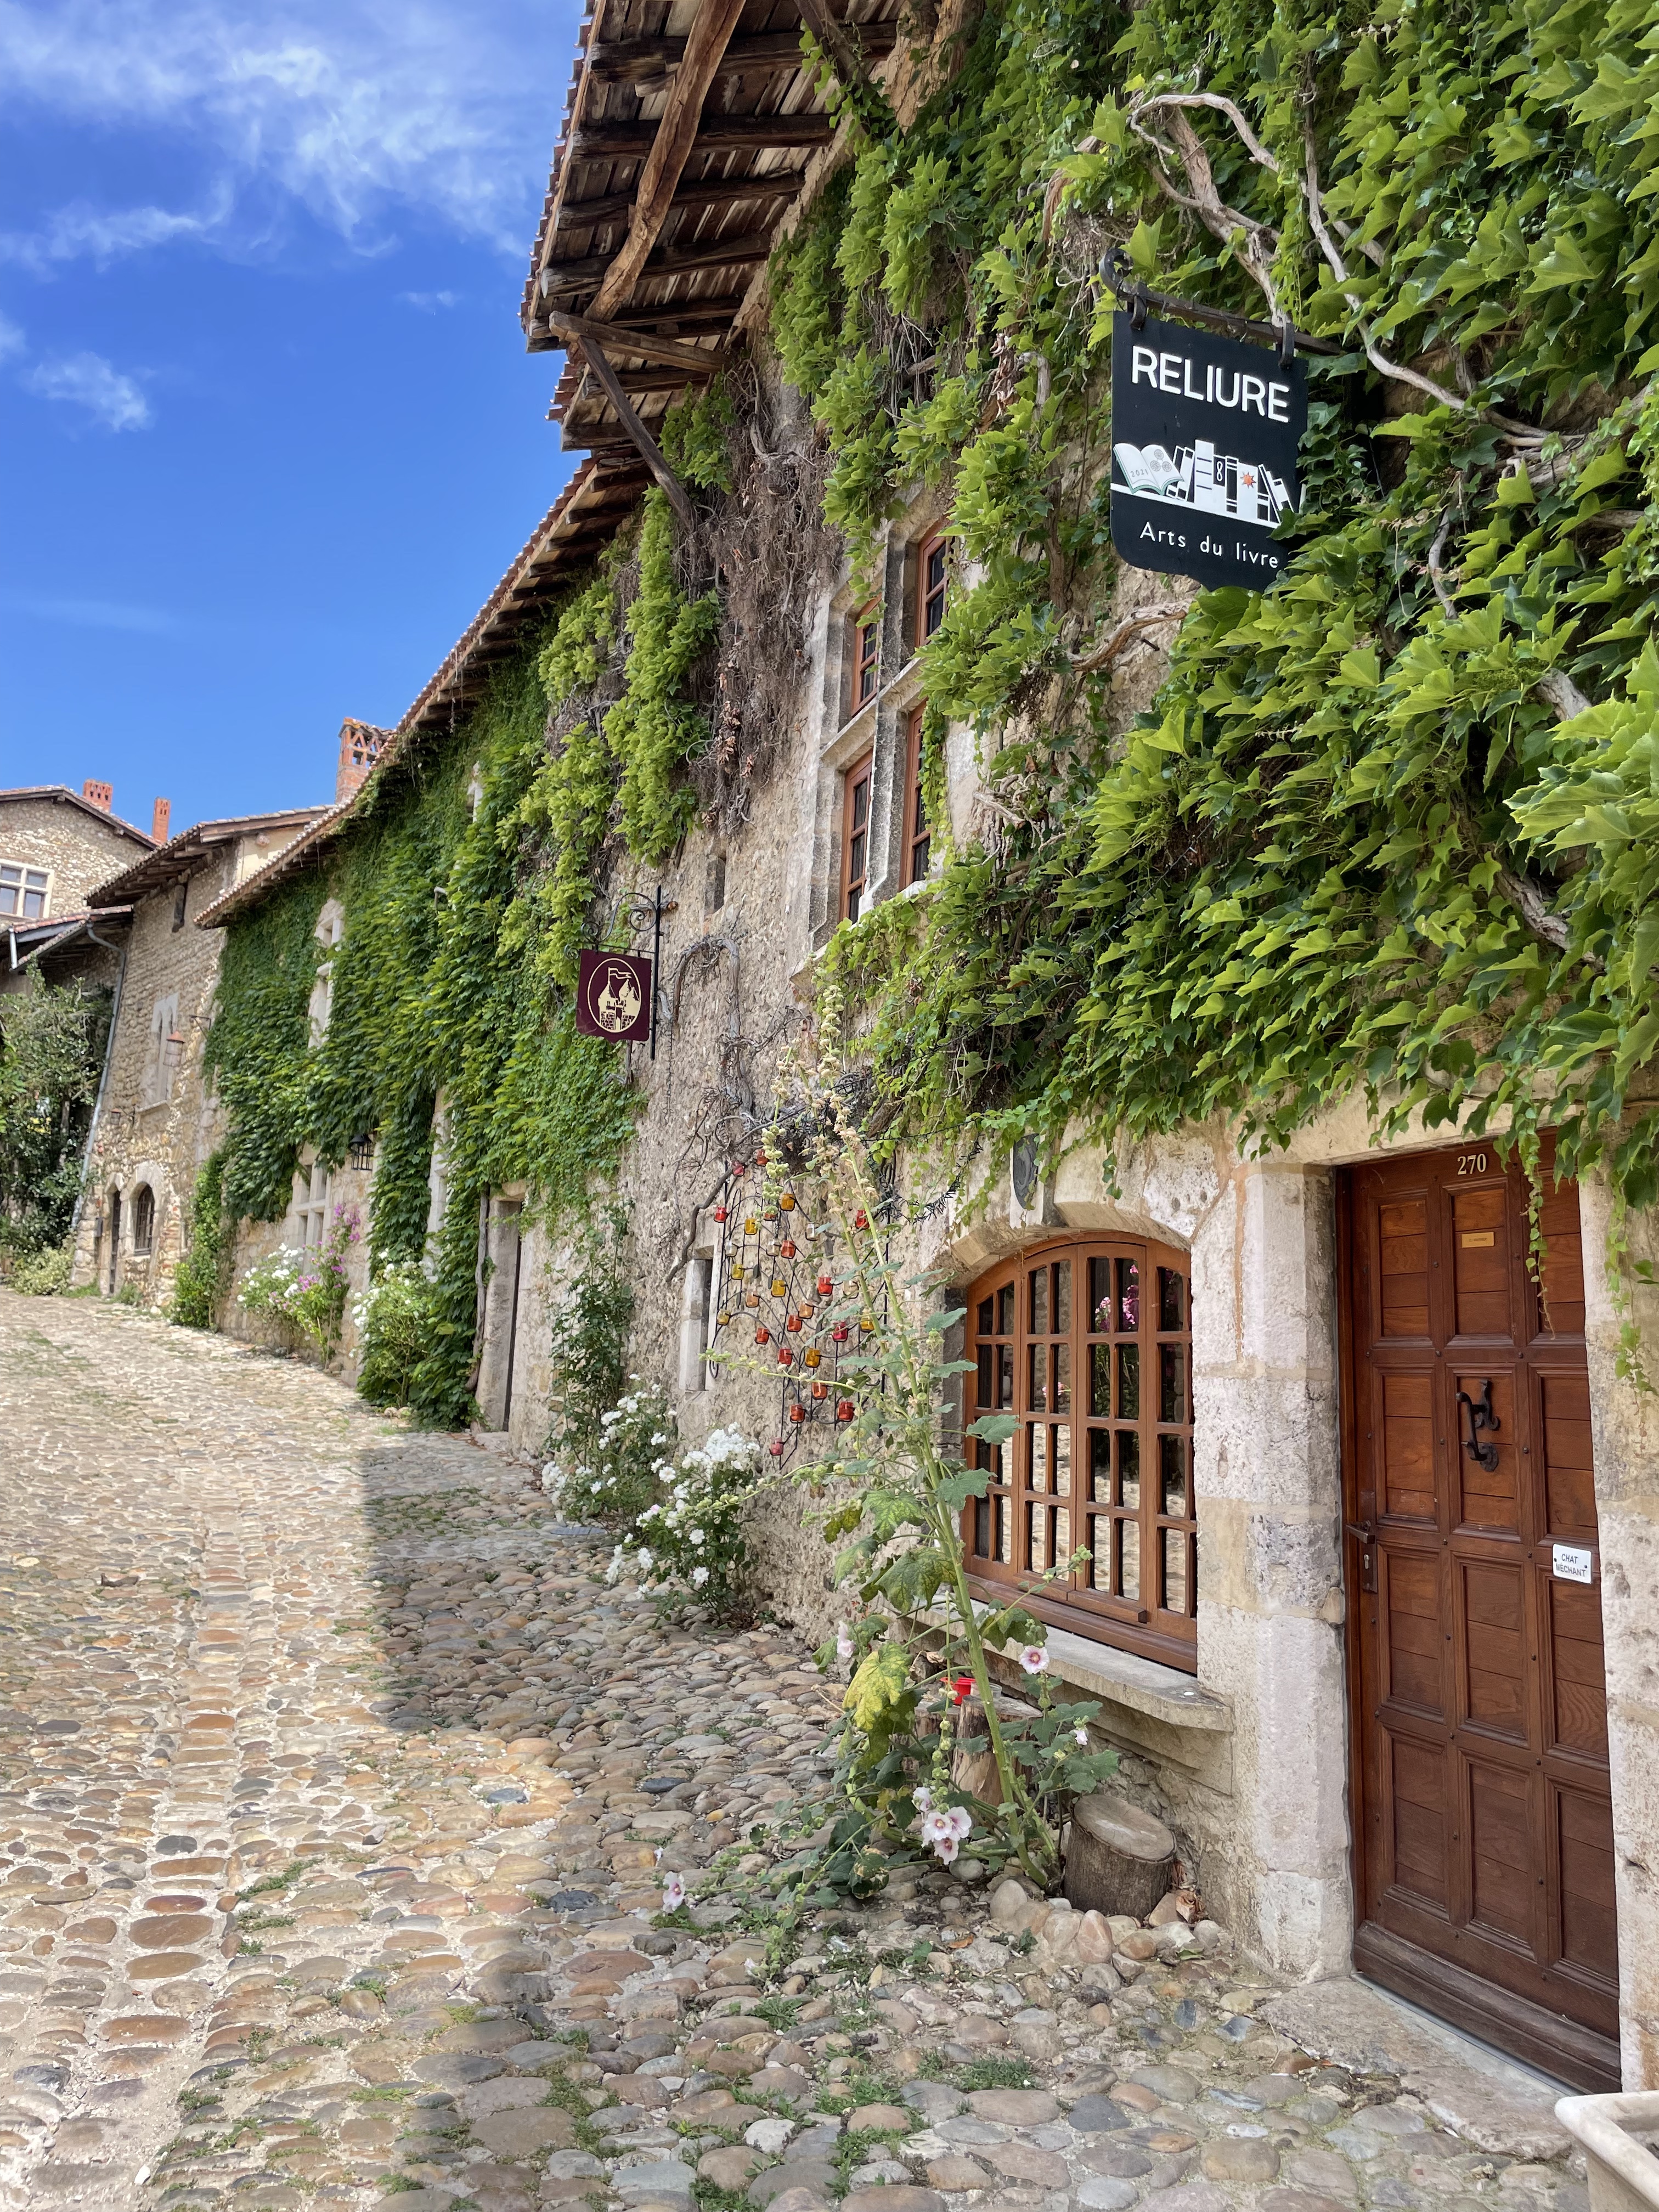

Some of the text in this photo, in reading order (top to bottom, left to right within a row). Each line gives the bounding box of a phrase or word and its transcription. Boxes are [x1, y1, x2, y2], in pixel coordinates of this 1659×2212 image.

[1132, 345, 1289, 422] RELIURE
[1130, 469, 1149, 477] 2021
[1139, 521, 1278, 568] Arts du livre
[1457, 1153, 1487, 1175] 270
[1561, 1553, 1578, 1564] CHAT
